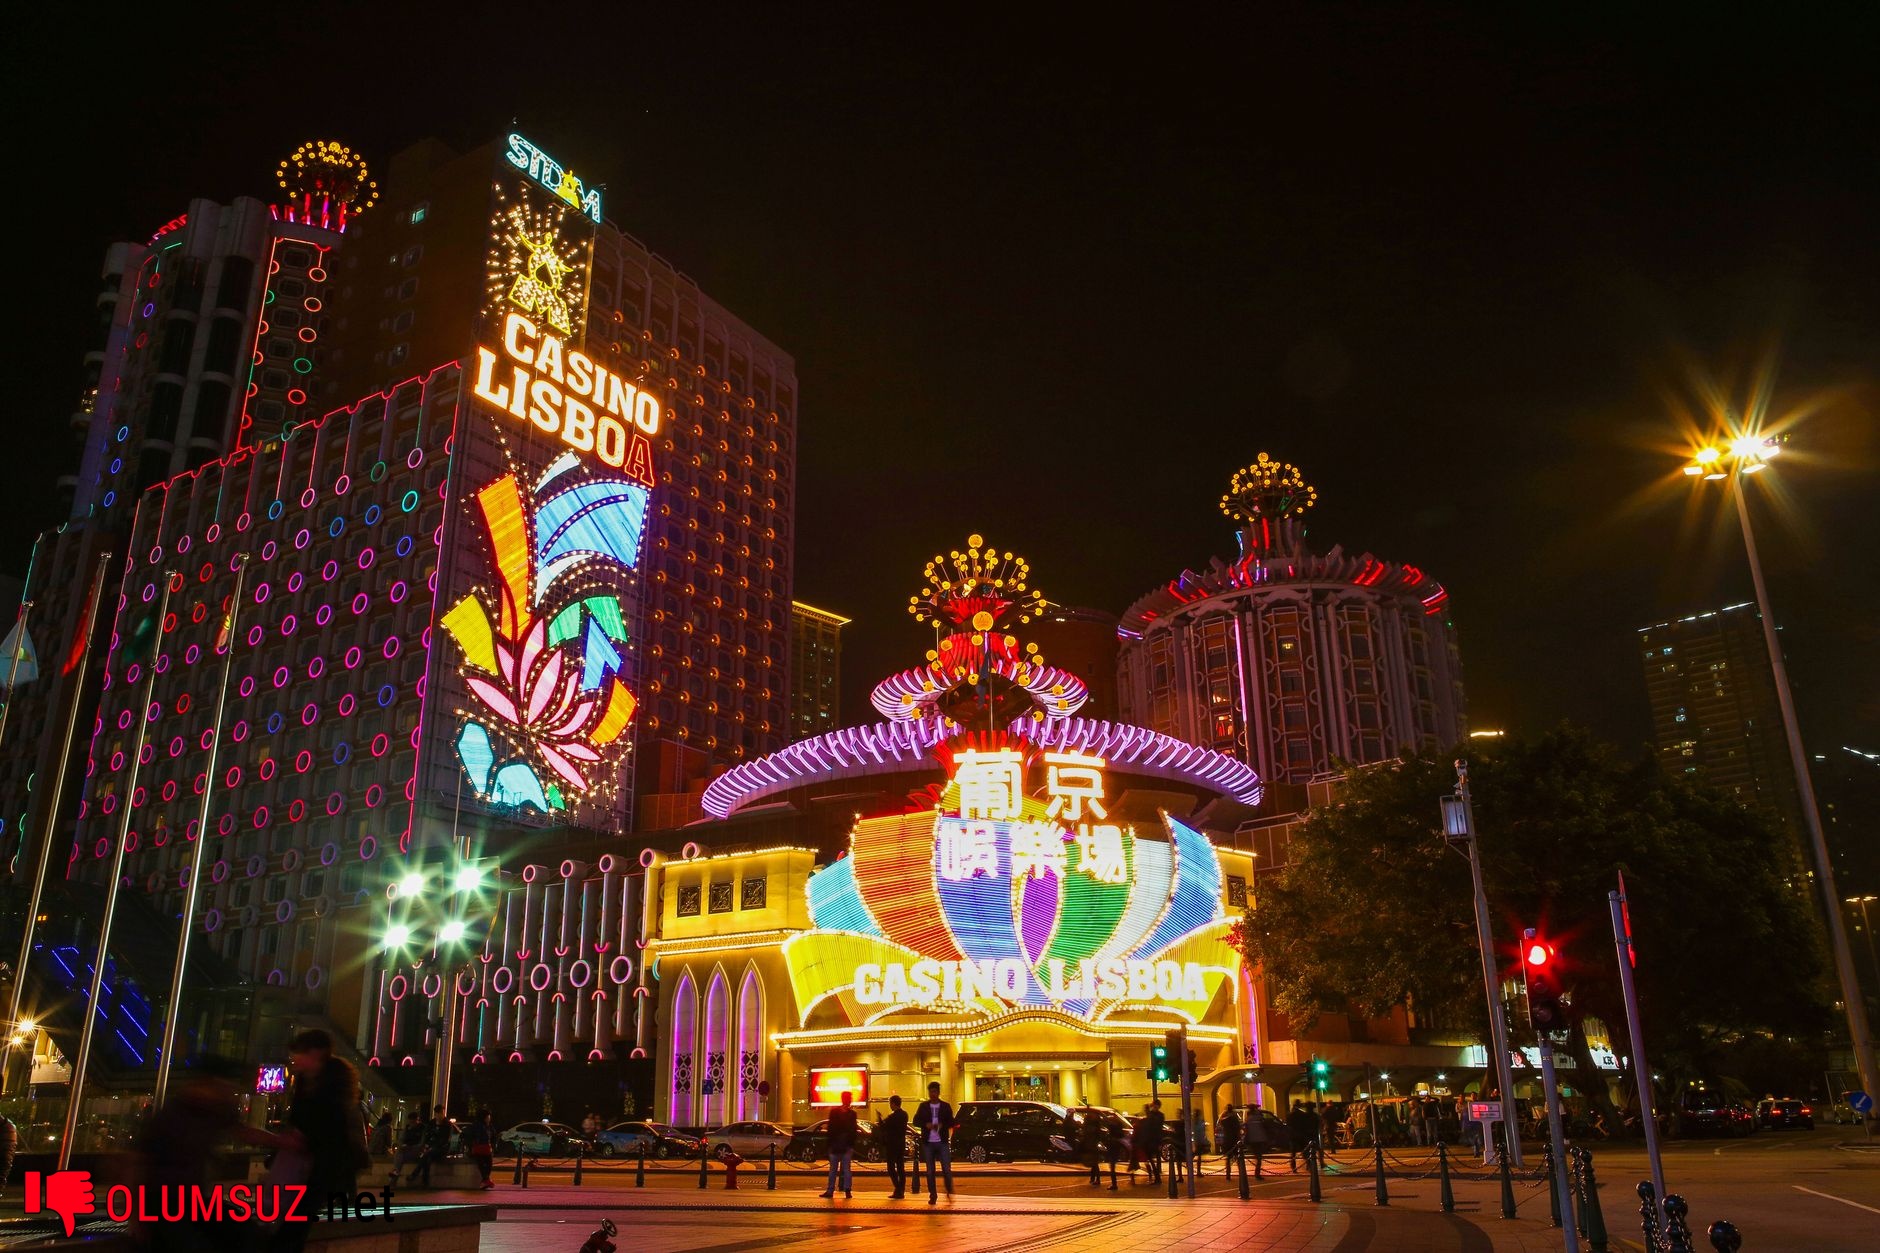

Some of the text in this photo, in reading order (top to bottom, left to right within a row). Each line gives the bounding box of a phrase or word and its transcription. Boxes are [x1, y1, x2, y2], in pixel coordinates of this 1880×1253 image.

[474, 346, 654, 487] LISBOA
[504, 313, 659, 434] CASINO
[954, 747, 1108, 820] 葡京
[853, 958, 1208, 1004] CASINO LISBOA
